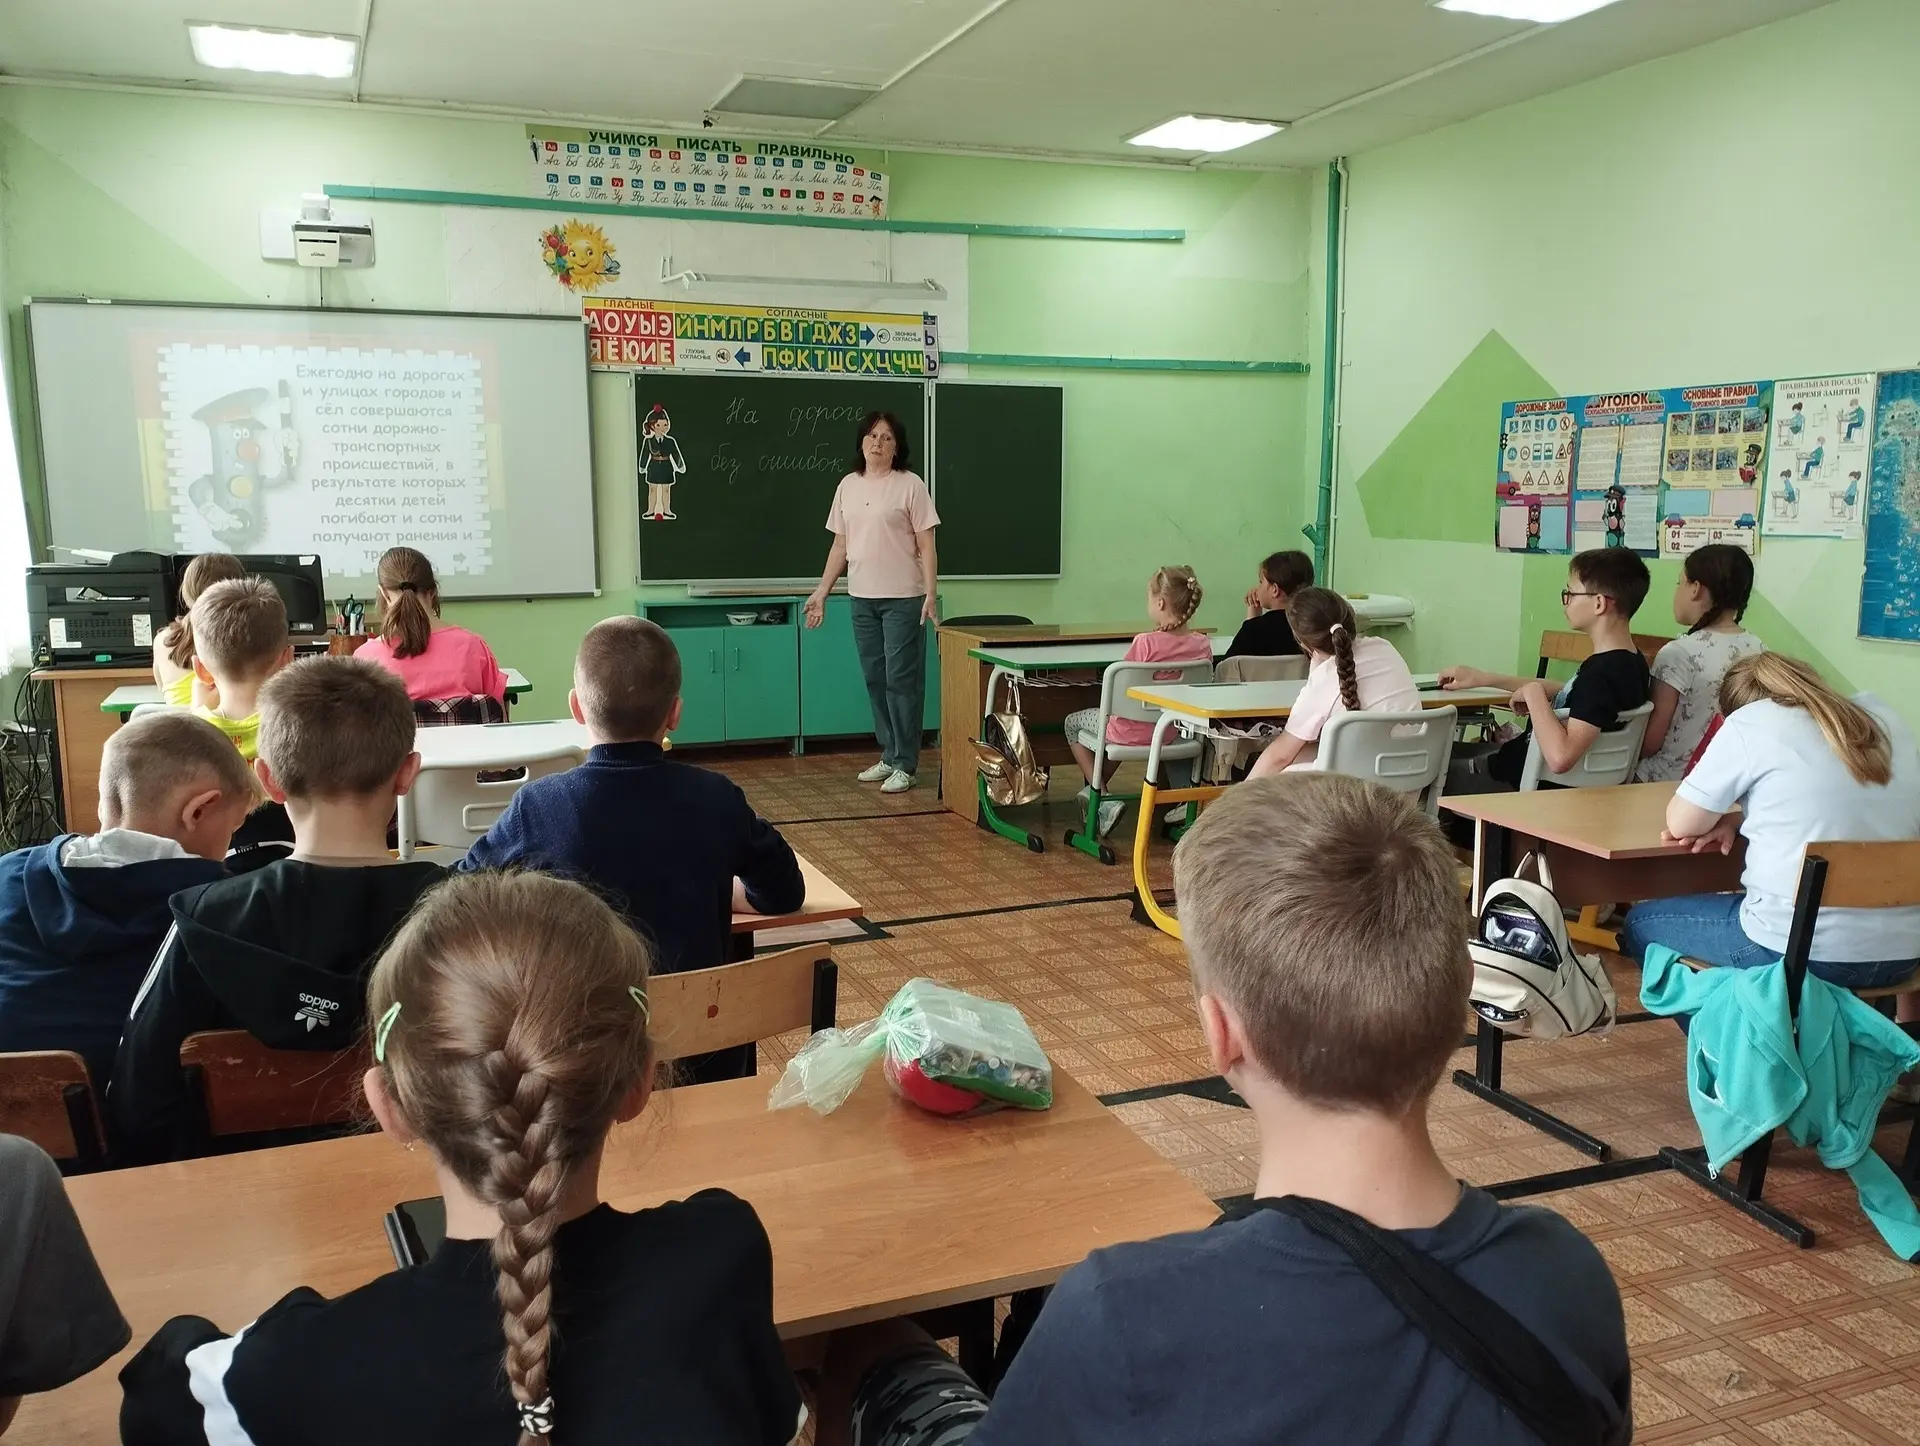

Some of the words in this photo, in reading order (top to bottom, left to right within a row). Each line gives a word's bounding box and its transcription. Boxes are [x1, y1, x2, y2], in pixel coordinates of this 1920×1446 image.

[589, 131, 657, 147] УЧИМСЯ
[677, 138, 742, 152] ПИСАТЬ
[758, 144, 854, 164] ПРАВИЛЬНО
[604, 300, 654, 310] ГЛАСНЫЕ
[766, 308, 828, 320] СОГЛАСНЫЕ
[296, 364, 372, 380] Ежегодно
[378, 370, 396, 380] на
[403, 370, 465, 384] дорогах
[1780, 380, 1829, 390] ПРАВИЛЬНАЯ
[1832, 376, 1868, 386] ПОСАДКА
[303, 387, 312, 396] и
[320, 388, 378, 399] улицах
[385, 388, 445, 400] городов
[452, 390, 462, 399] и
[1683, 388, 1722, 400] ОСНОВНЫЕ
[1724, 385, 1757, 397] ПРАВИЛА
[1798, 390, 1821, 398] ВРЕМЯ
[1824, 387, 1860, 396] ЗАНЯТИЙ
[1600, 392, 1648, 407] УГОЛОК
[316, 403, 344, 415] сёл
[350, 406, 452, 418] совершаются
[726, 396, 759, 424] На
[1516, 402, 1547, 414] ДОРОЖНЫЕ
[1548, 400, 1566, 410] ЗНАКИ
[322, 424, 367, 434] сотни
[373, 425, 446, 437] дорожно-
[332, 442, 440, 455] транспортных
[322, 458, 439, 472] происшествий,
[446, 462, 453, 470] в
[711, 442, 744, 485] без
[759, 442, 844, 473] ошибок
[312, 478, 396, 491] результате
[402, 478, 466, 491] которых
[335, 496, 395, 506] десятки
[402, 494, 445, 506] детей
[321, 512, 397, 524] погибают
[403, 514, 412, 523] и
[420, 514, 462, 524] сотни
[313, 532, 390, 544] получают
[396, 532, 457, 544] ранения
[463, 532, 472, 540] и
[1672, 530, 1680, 538] 01
[1713, 531, 1722, 539] 03
[1672, 542, 1680, 550] 02
[299, 993, 340, 1010] adidas
